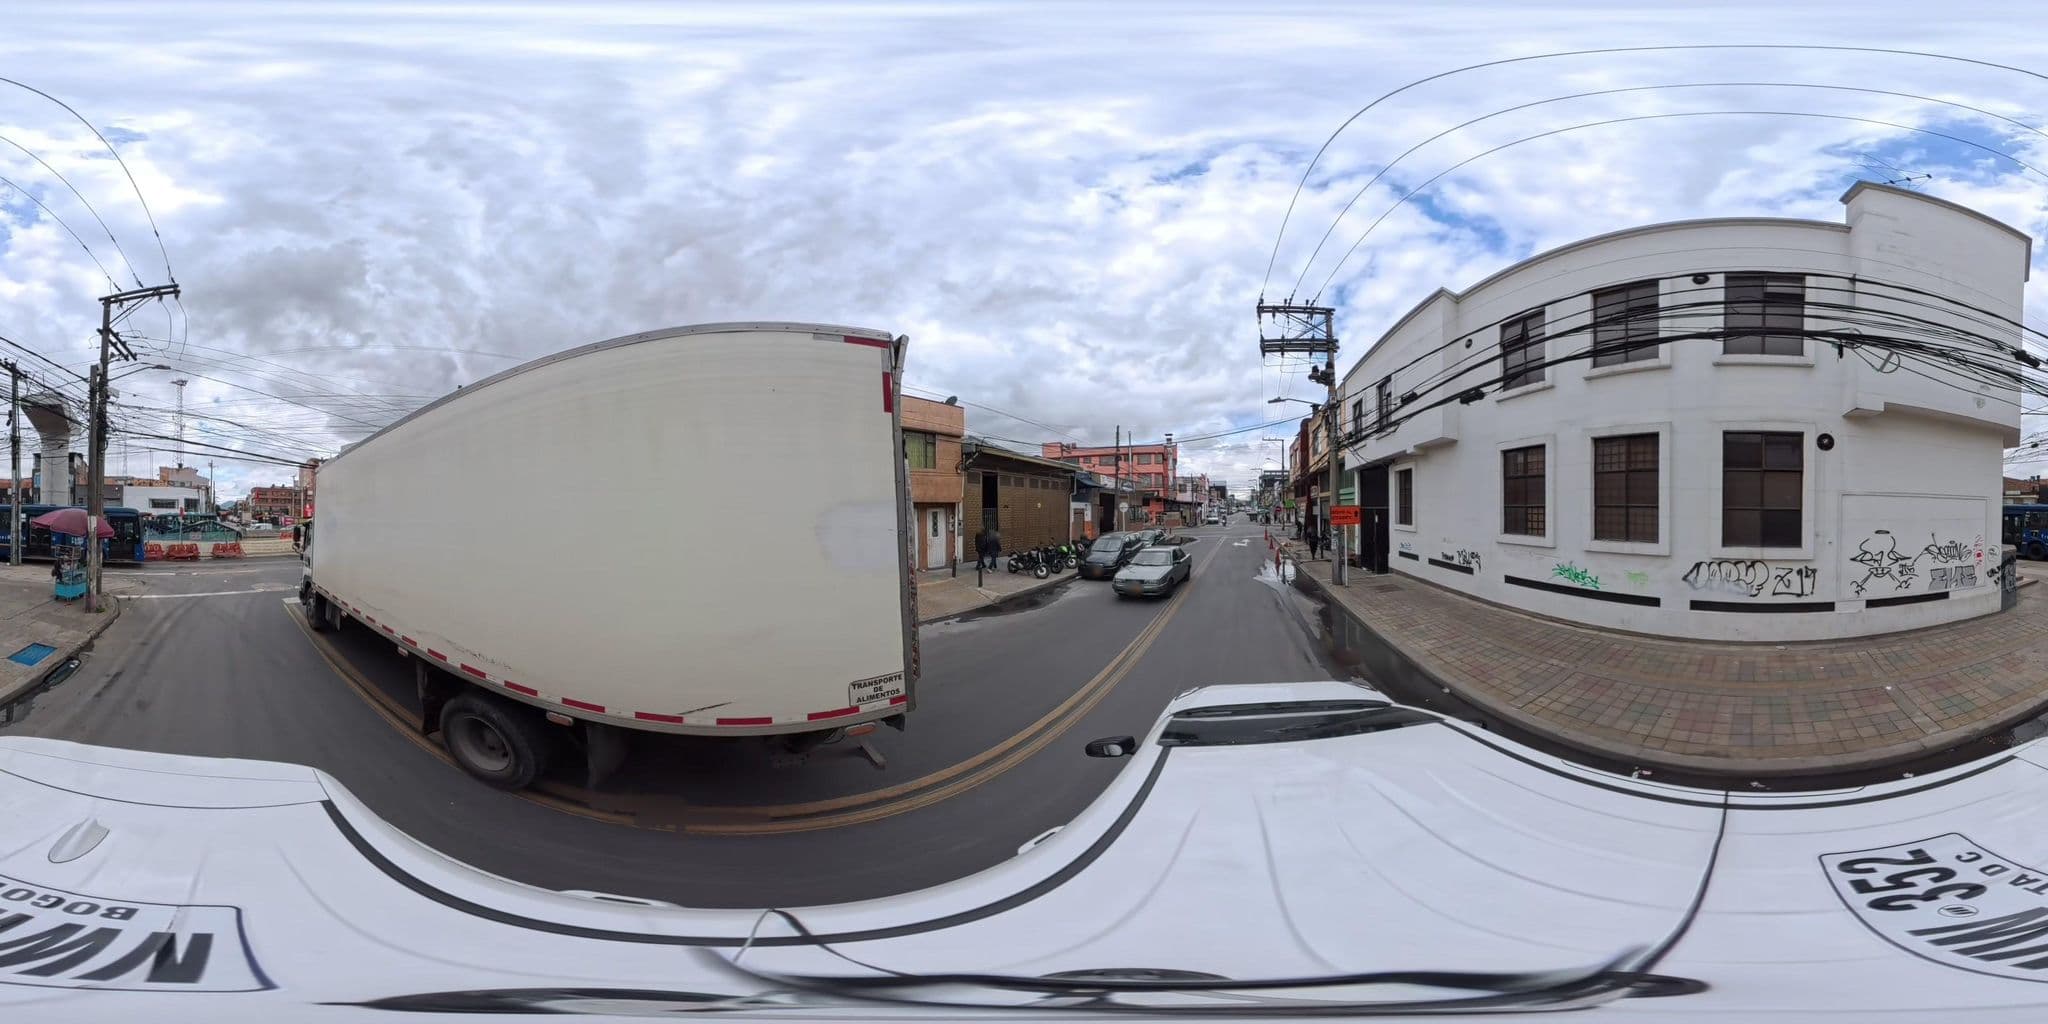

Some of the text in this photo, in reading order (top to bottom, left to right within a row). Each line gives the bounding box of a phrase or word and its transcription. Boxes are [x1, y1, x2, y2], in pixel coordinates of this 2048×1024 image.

[851, 673, 903, 690] TRANSPORTE
[873, 685, 884, 693] DE
[856, 688, 901, 704] ALIMENTOS
[1955, 851, 1983, 863] C
[1978, 863, 2011, 877] D
[1837, 848, 1988, 912] 352
